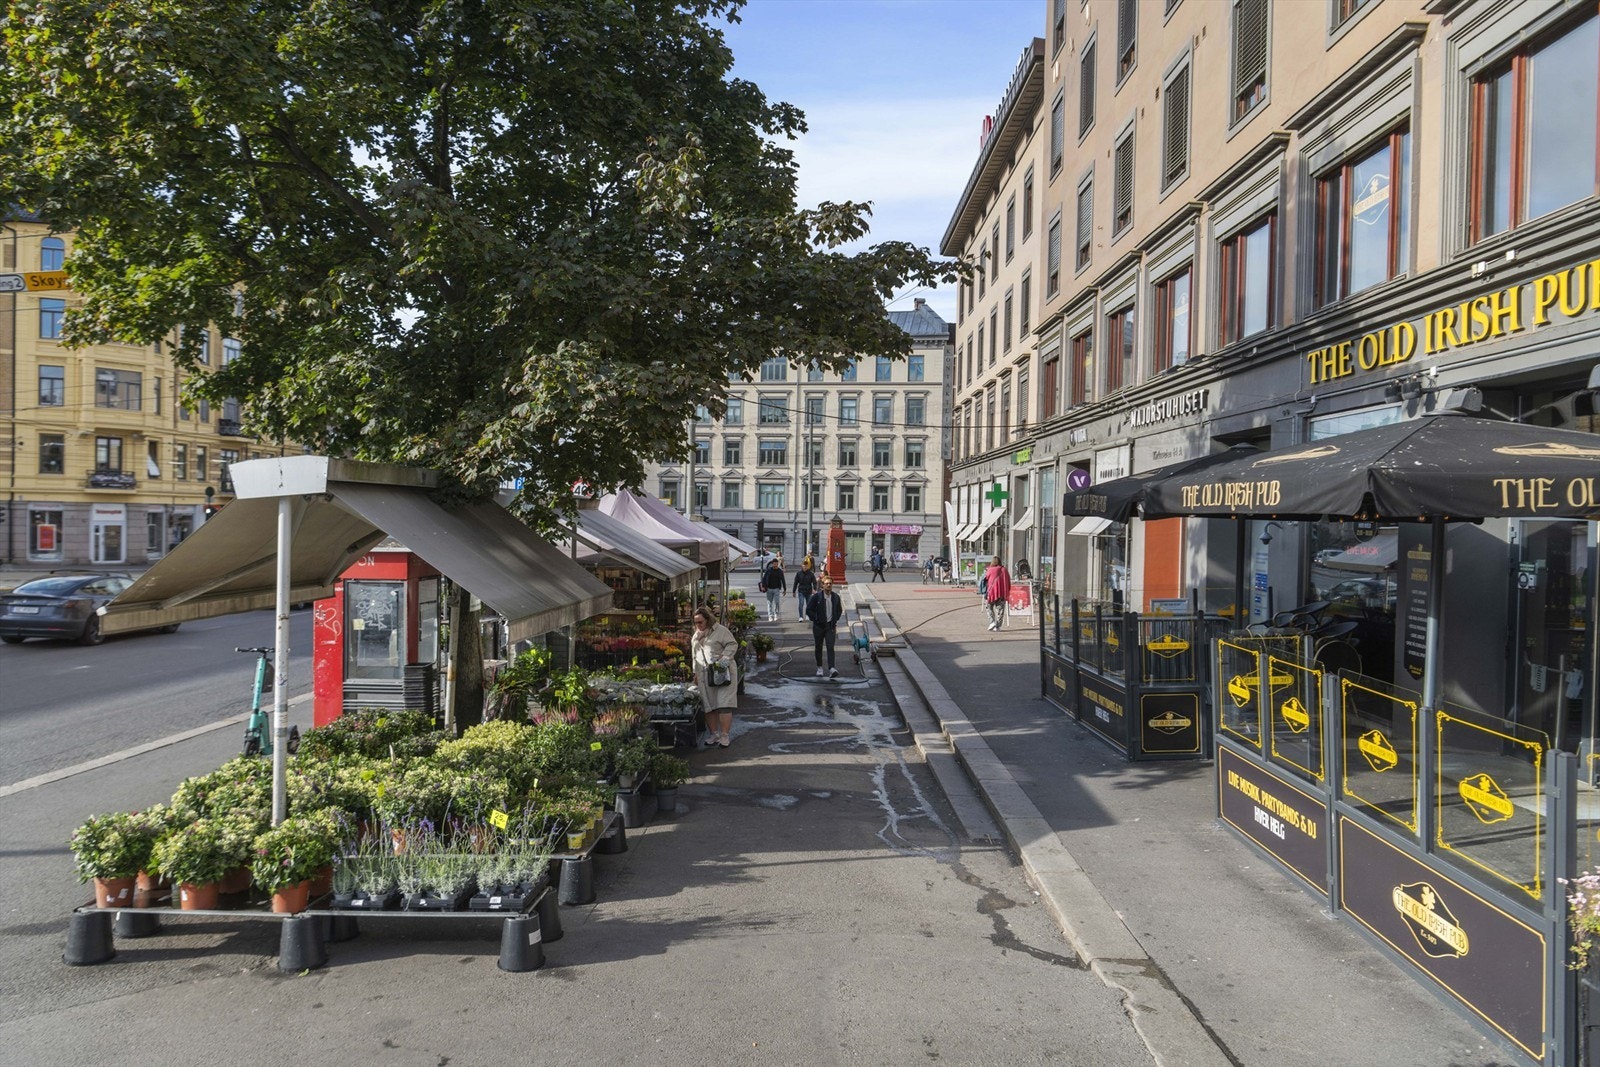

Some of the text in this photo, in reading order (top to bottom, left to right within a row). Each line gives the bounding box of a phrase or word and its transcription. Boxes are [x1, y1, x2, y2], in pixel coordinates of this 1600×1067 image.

[1307, 341, 1353, 384] THE
[1357, 322, 1415, 371] OLD
[1424, 285, 1521, 355] IRISH
[1131, 389, 1205, 428] MAJORSTUHUSET
[1181, 480, 1281, 511] THE OLD IRISH PUB
[1493, 477, 1559, 513] THE
[1261, 790, 1299, 828] PARTYBANDS
[1300, 815, 1307, 834] &
[1307, 819, 1316, 839] DJ
[1270, 816, 1285, 840] HELG
[1396, 891, 1410, 912] THE
[1412, 904, 1426, 922] OLD
[1429, 914, 1447, 938] IRISH
[1450, 928, 1465, 949] PUB
